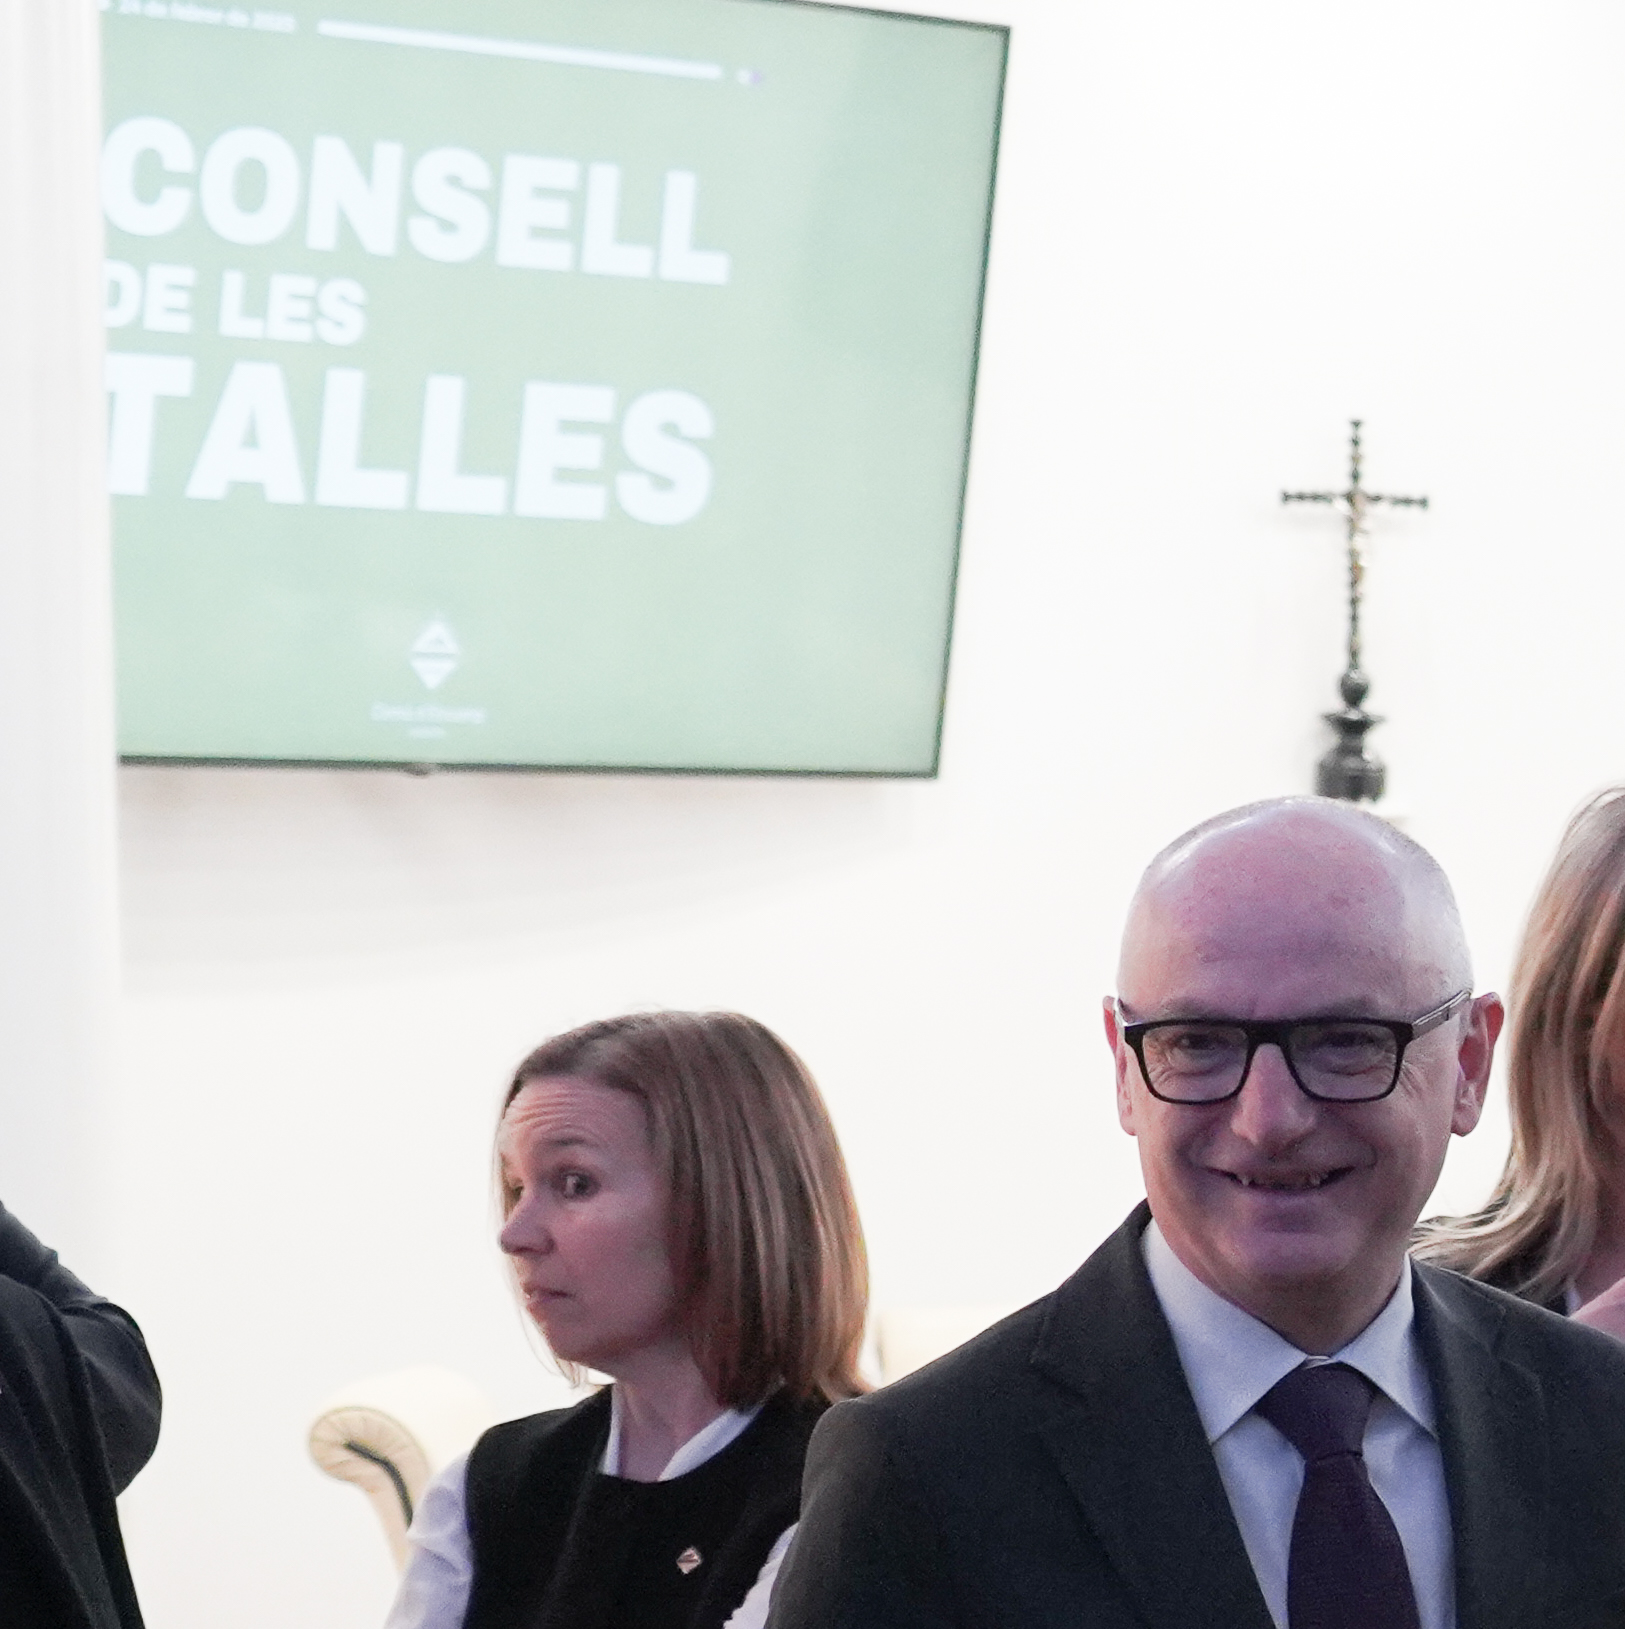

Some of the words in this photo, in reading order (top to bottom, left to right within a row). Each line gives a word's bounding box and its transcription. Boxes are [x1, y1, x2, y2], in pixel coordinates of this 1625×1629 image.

[102, 117, 732, 287] CONSELL
[105, 261, 197, 334] DE
[219, 270, 368, 346] LES
[107, 351, 716, 527] TALLES
